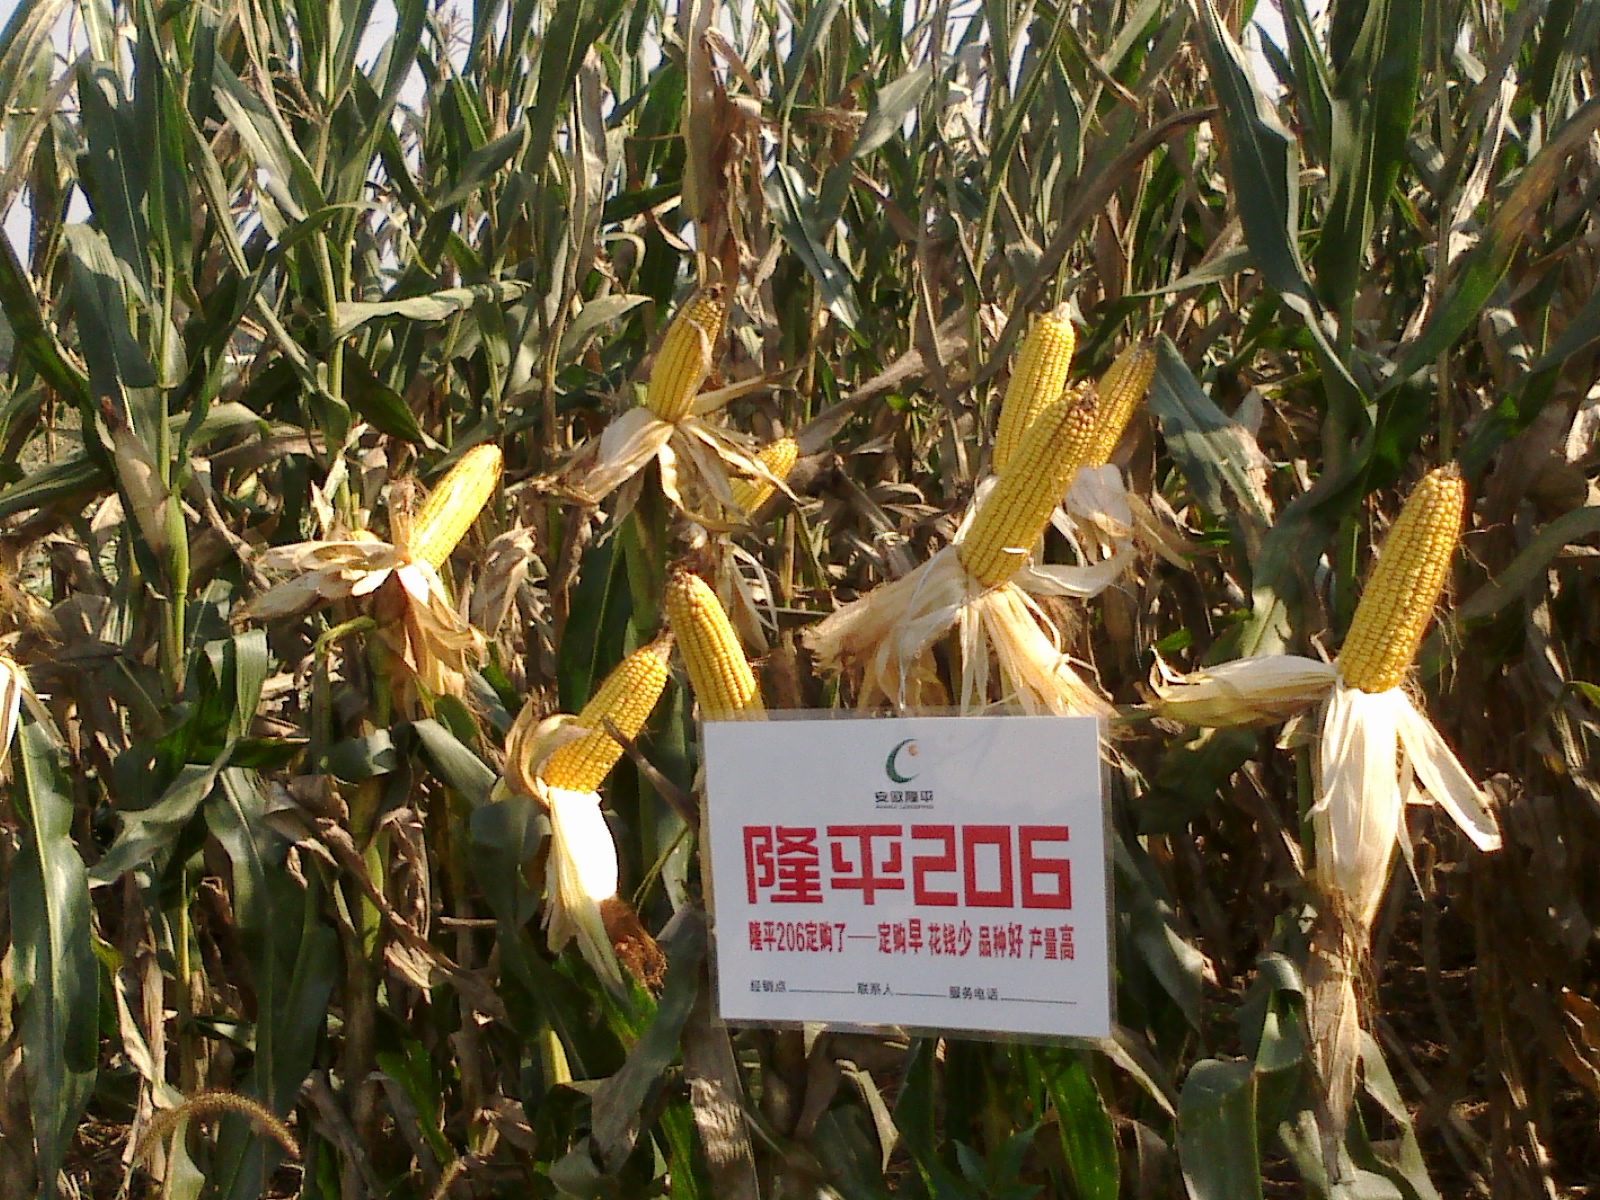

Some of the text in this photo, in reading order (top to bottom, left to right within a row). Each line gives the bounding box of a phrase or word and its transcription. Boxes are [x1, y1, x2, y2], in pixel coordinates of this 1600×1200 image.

[742, 824, 1072, 909] 隆平206
[928, 920, 972, 957] 花钱少
[978, 922, 1023, 959] 品种好
[1029, 924, 1075, 960] 产量高
[750, 980, 998, 1001] 经销点 联系人 服务电话
